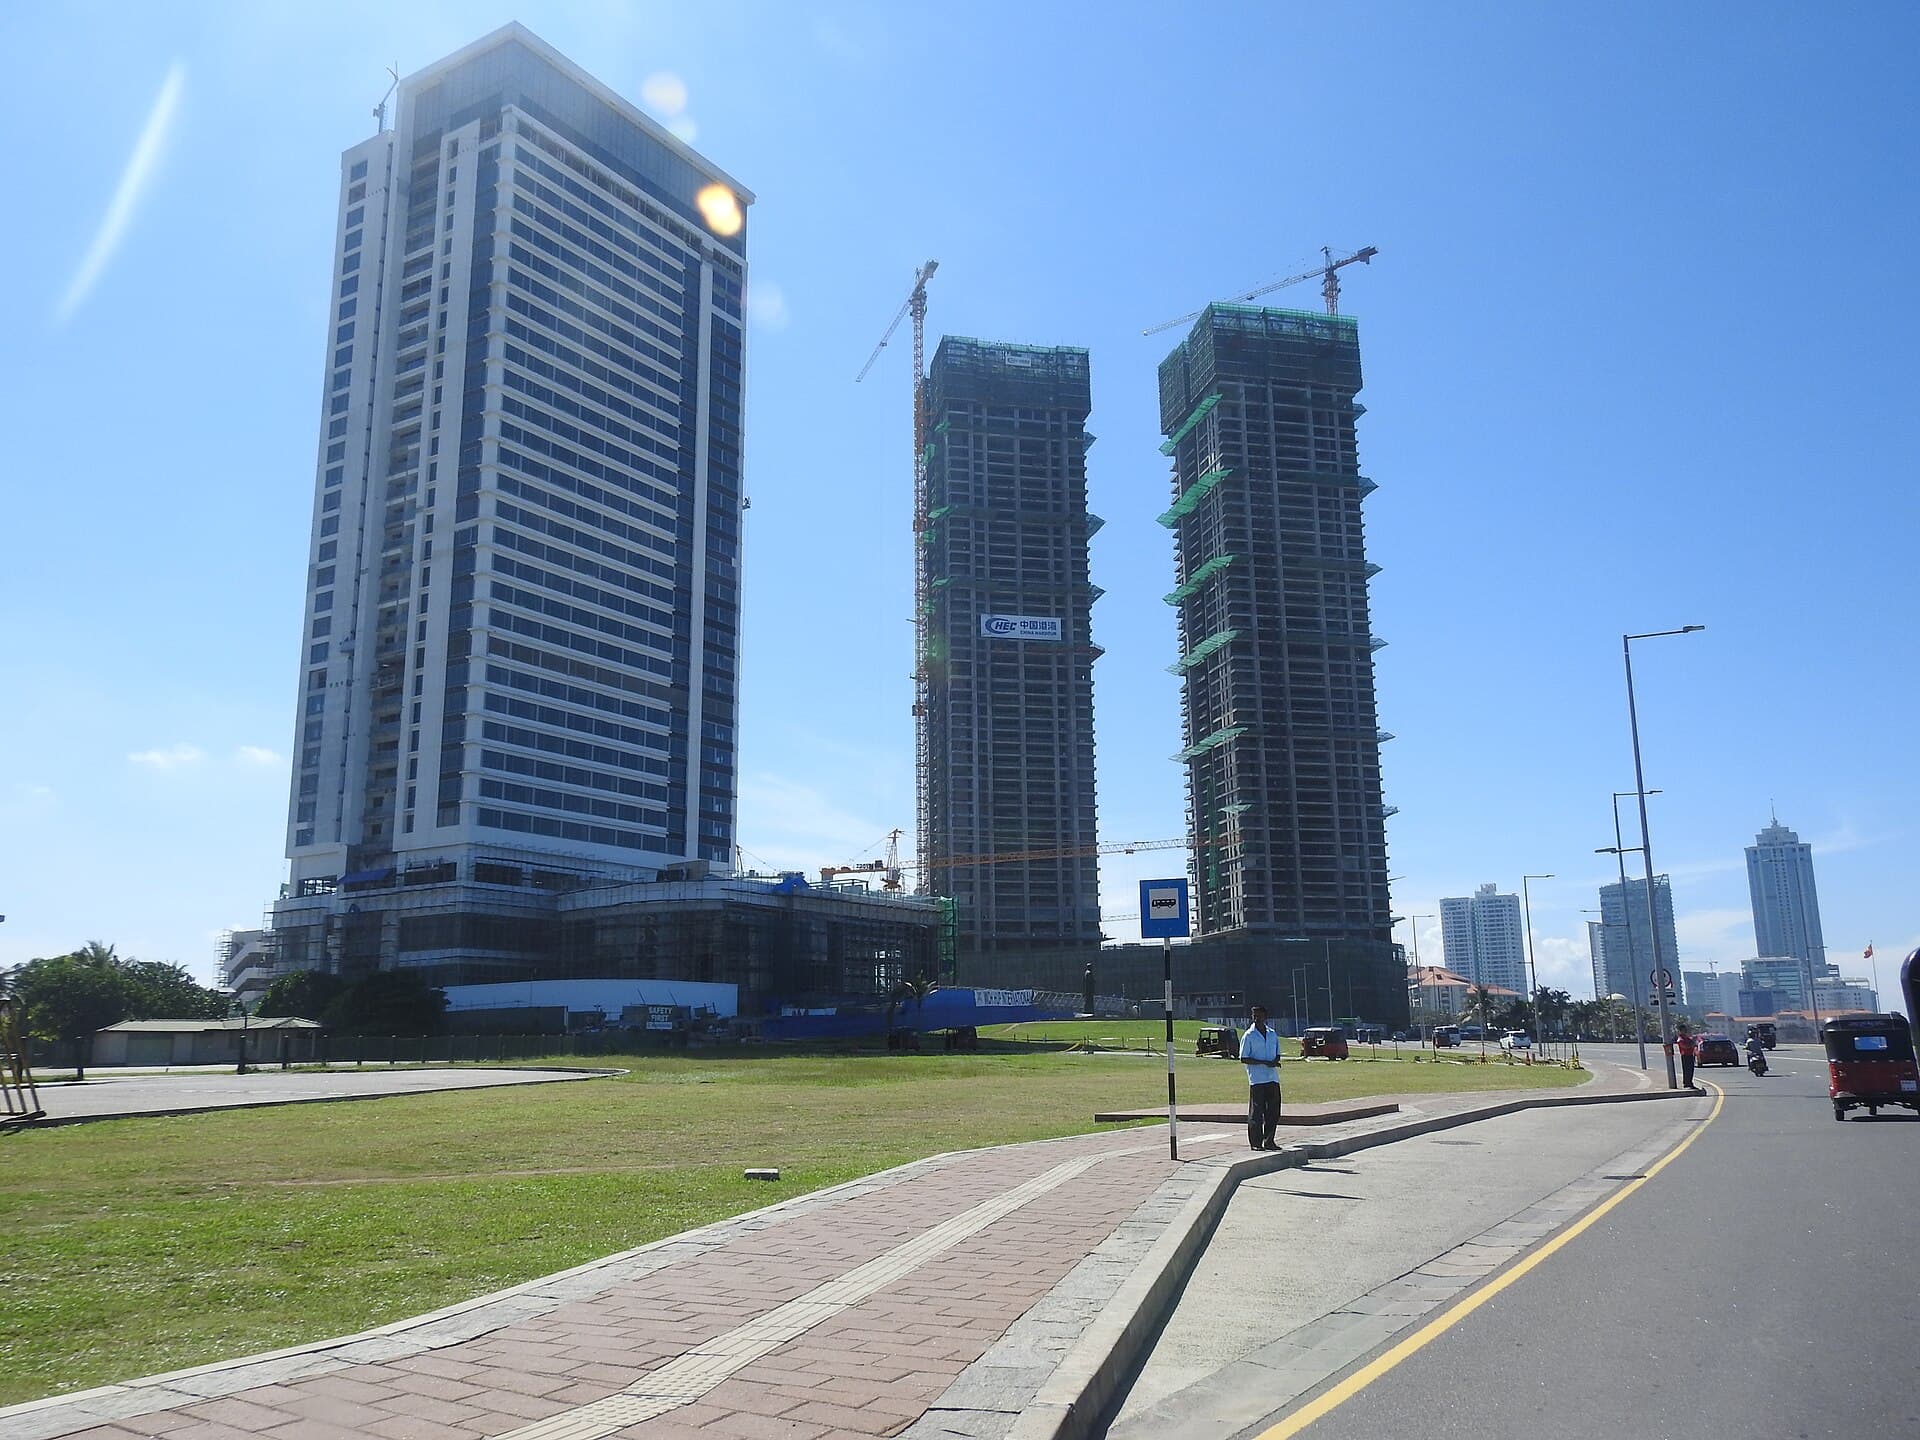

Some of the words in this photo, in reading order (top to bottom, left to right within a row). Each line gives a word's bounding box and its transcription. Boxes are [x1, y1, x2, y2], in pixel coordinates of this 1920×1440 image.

[985, 618, 1017, 634] CHEC
[1020, 621, 1057, 631] 中国港湾
